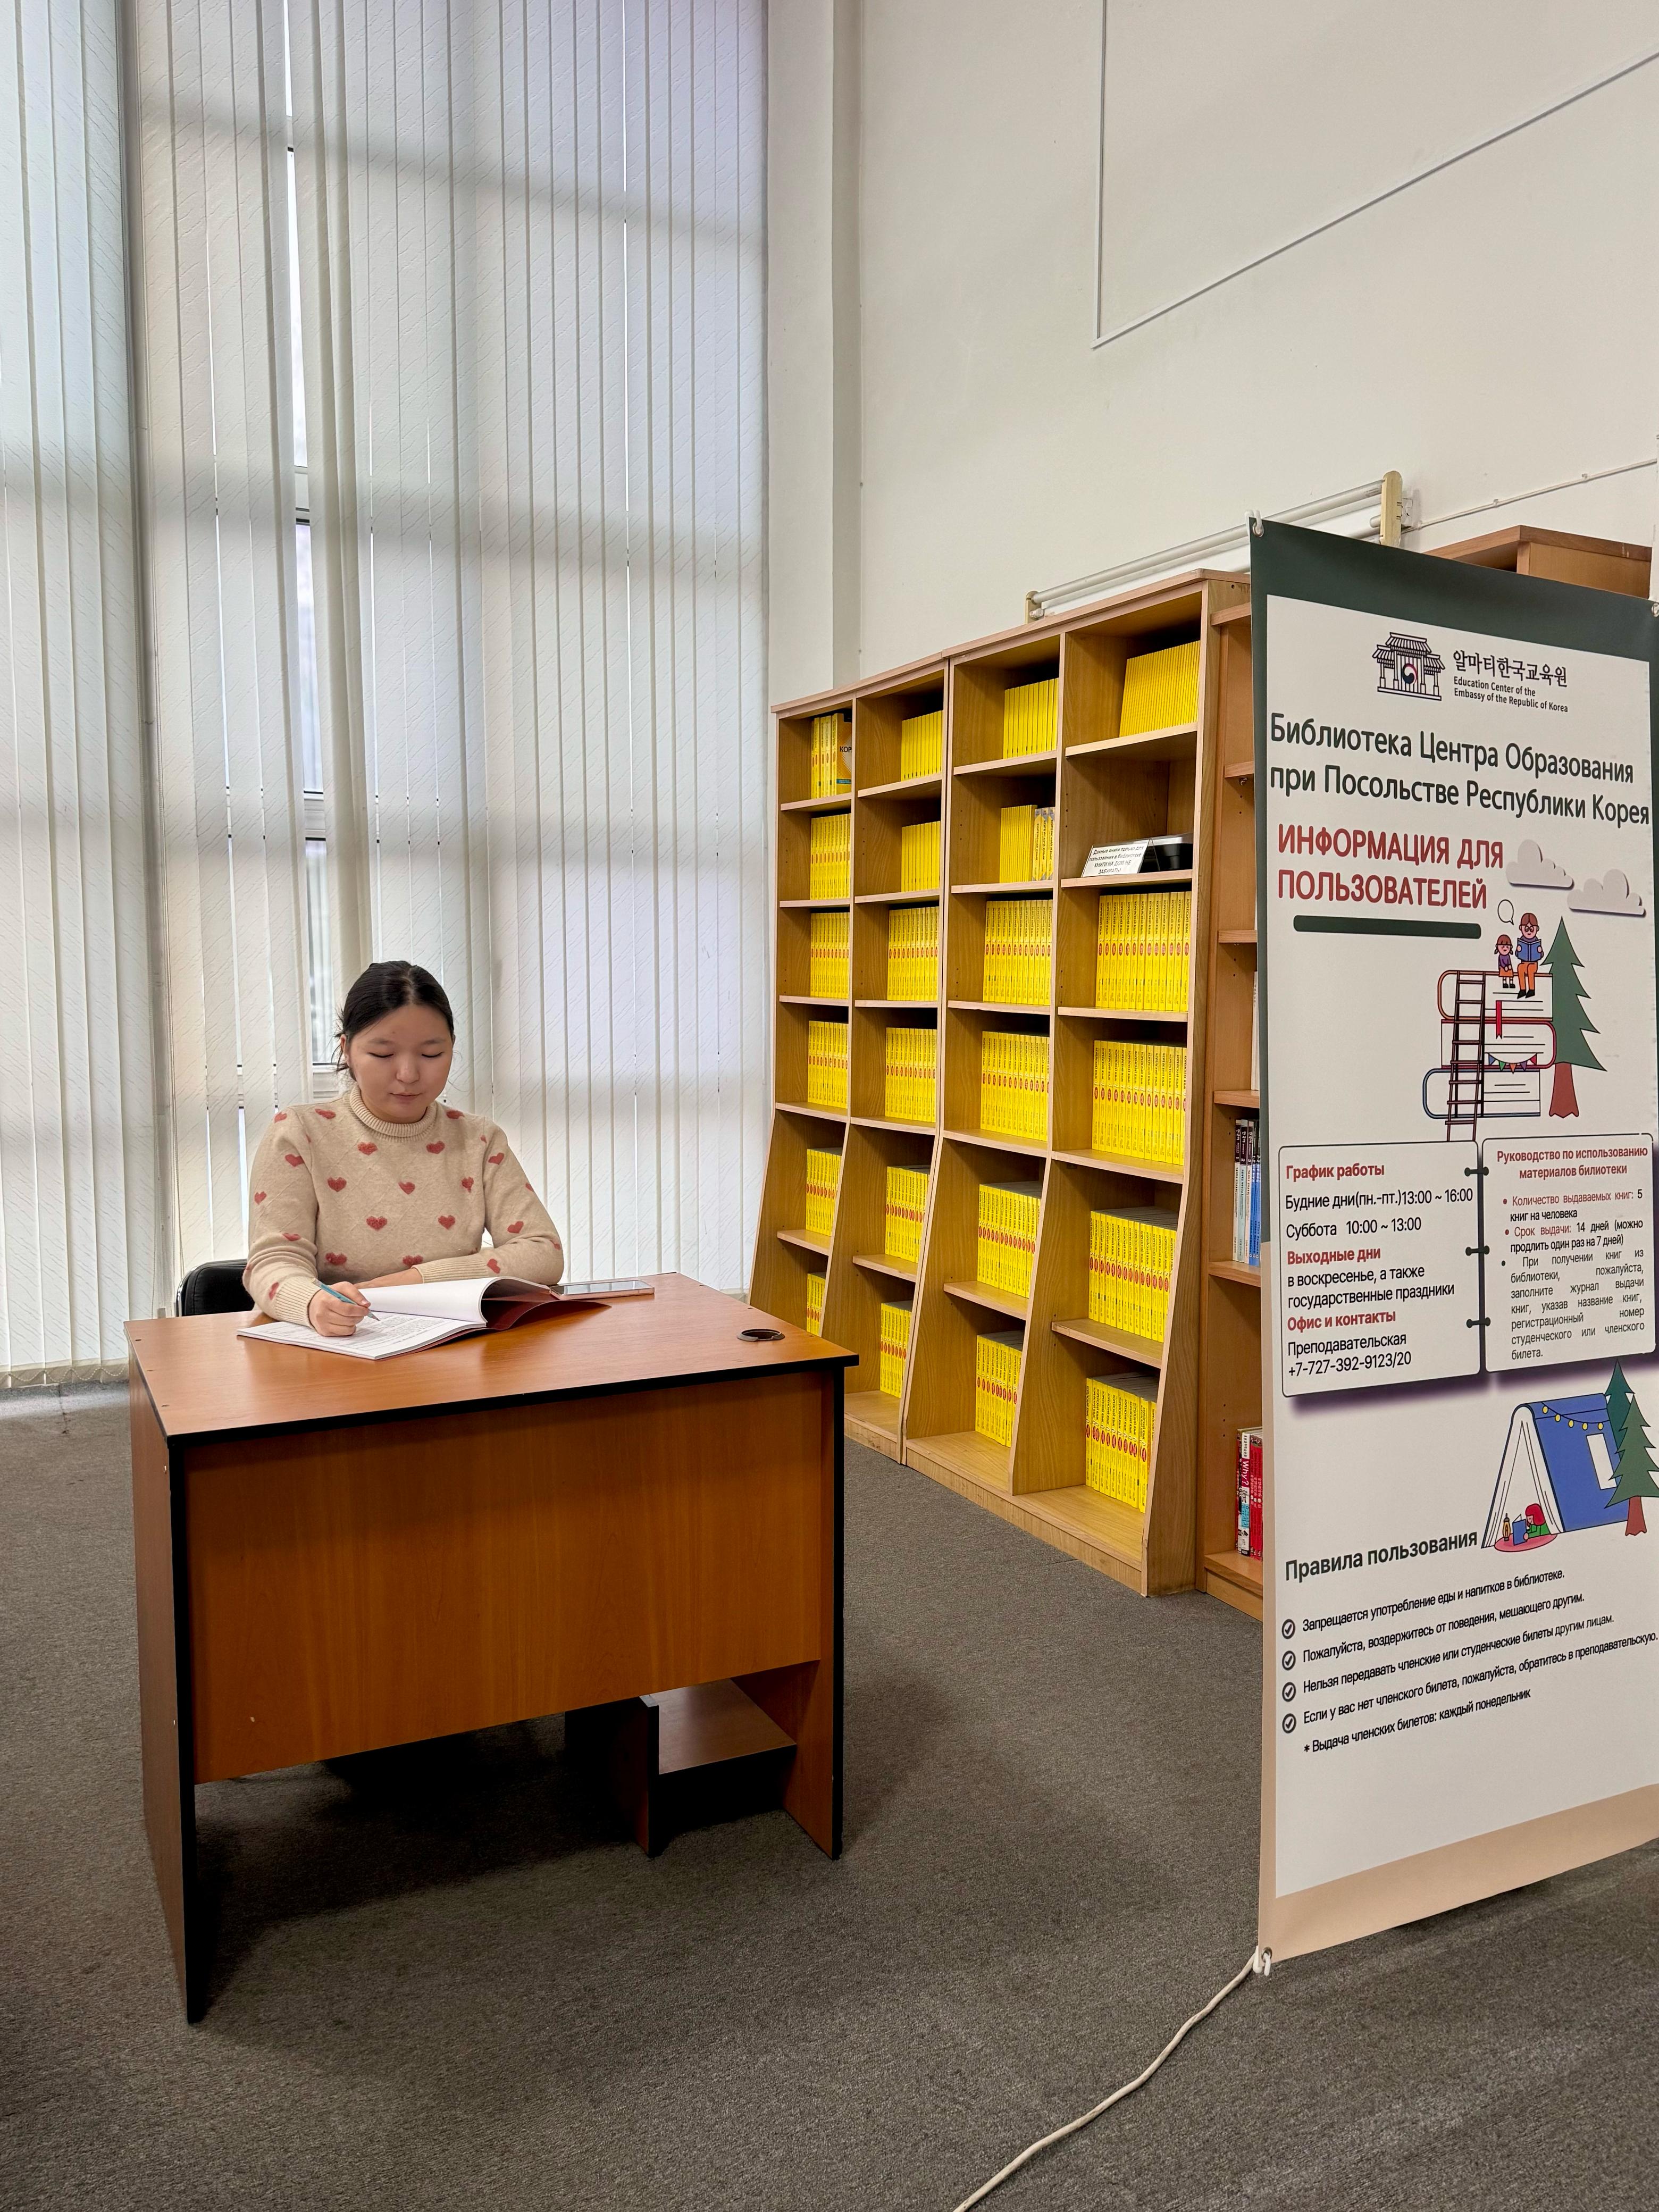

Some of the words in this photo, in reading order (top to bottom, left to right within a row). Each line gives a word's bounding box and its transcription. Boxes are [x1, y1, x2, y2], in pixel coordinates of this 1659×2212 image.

[1453, 650, 1567, 688] 알마티한국교육원
[1454, 676, 1489, 690] Education
[1491, 682, 1514, 693] Center
[1515, 686, 1523, 694] of
[1524, 687, 1536, 697] the
[1454, 688, 1485, 702] Embassy
[1487, 693, 1494, 701] of
[1495, 694, 1507, 703] the
[1509, 696, 1538, 708] Republic
[1540, 701, 1547, 709] of
[1549, 702, 1568, 712] Korea
[1271, 713, 1412, 757] Библиотека
[1420, 731, 1498, 772] Центра
[1505, 743, 1633, 784] Образования
[1271, 767, 1316, 797] при
[1325, 765, 1459, 805] Посольстве
[1467, 780, 1585, 818] Республики
[1593, 794, 1649, 828] Корея
[1279, 824, 1449, 866] ИНФОРМАЦИЯ
[1457, 839, 1503, 870] ДЛЯ
[1278, 869, 1486, 909] ПОЛЬЗОВАТЕЛЕЙ
[1497, 1151, 1561, 1164] Руководство
[1563, 1150, 1574, 1159] по
[1576, 1147, 1648, 1159] использованию
[1286, 1164, 1335, 1183] График
[1337, 1162, 1385, 1180] работы
[1519, 1168, 1577, 1180] материалов
[1286, 1195, 1330, 1212] Будние
[1445, 1188, 1473, 1202] 16:00
[1512, 1196, 1560, 1206] Количество
[1563, 1193, 1611, 1205] выдаваемых
[1615, 1192, 1633, 1200] книг:
[1637, 1189, 1643, 1199] 5
[1510, 1213, 1529, 1222] книг
[1530, 1212, 1540, 1221] на
[1541, 1210, 1578, 1220] человека
[1286, 1222, 1337, 1241] Суббота
[1346, 1219, 1378, 1234] 10:00
[1391, 1217, 1421, 1232] 13:00
[1514, 1226, 1535, 1239] Срок
[1540, 1225, 1571, 1236] выдачи:
[1577, 1222, 1586, 1233] 14
[1590, 1220, 1609, 1233] дней
[1614, 1219, 1643, 1231] (можно
[1287, 1250, 1355, 1265] Выходные
[1357, 1248, 1381, 1263] дни
[1511, 1242, 1549, 1255] продлить
[1551, 1240, 1570, 1251] один
[1571, 1239, 1585, 1250] раз
[1586, 1238, 1595, 1247] на
[1596, 1236, 1602, 1246] 7
[1603, 1234, 1623, 1247] дней)
[1523, 1256, 1538, 1269] При
[1552, 1253, 1593, 1266] получении
[1606, 1251, 1622, 1260] книг
[1288, 1276, 1294, 1287] в
[1297, 1270, 1377, 1288] воскресенье,
[1380, 1270, 1386, 1280] а
[1389, 1267, 1425, 1279] также
[1511, 1271, 1560, 1283] библиотеки,
[1596, 1264, 1644, 1276] пожалуйста,
[1288, 1289, 1393, 1310] государственные
[1396, 1284, 1454, 1302] праздники
[1511, 1287, 1553, 1299] заполните
[1570, 1283, 1599, 1295] журнал
[1615, 1278, 1644, 1289] выдачи
[1511, 1304, 1531, 1314] книг,
[1541, 1301, 1568, 1313] указав
[1578, 1296, 1613, 1308] название
[1622, 1293, 1641, 1303] книг,
[1287, 1316, 1322, 1333] Офис
[1325, 1317, 1332, 1327] и
[1336, 1311, 1396, 1327] контакты
[1511, 1312, 1583, 1332] регистрационный
[1619, 1308, 1645, 1318] номер
[1511, 1330, 1572, 1346] студенческого
[1581, 1328, 1596, 1337] или
[1605, 1322, 1645, 1334] членского
[1288, 1334, 1406, 1359] Преподавательская
[1512, 1349, 1543, 1360] билета.
[1288, 1351, 1411, 1377] +7-727-392-9123/20
[1286, 1553, 1363, 1583] Правила
[1368, 1531, 1477, 1565] пользования
[1303, 1610, 1368, 1631] Запрещается
[1370, 1596, 1436, 1621] употребление
[1438, 1592, 1455, 1605] еды
[1457, 1590, 1463, 1600] и
[1465, 1582, 1505, 1598] напитков
[1507, 1580, 1512, 1589] в
[1514, 1570, 1564, 1588] библиотеке.
[1303, 1641, 1365, 1662] Пожалуйста,
[1368, 1626, 1434, 1648] воздержитесь
[1436, 1623, 1447, 1633] от
[1448, 1612, 1497, 1631] поведения,
[1499, 1601, 1551, 1620] мешающего
[1553, 1594, 1585, 1610] другим.
[1304, 1677, 1338, 1693] Нельзя
[1341, 1664, 1396, 1685] передавать
[1398, 1653, 1440, 1671] членские
[1443, 1649, 1459, 1661] или
[1461, 1635, 1521, 1657] студенческие
[1522, 1628, 1553, 1642] билеты
[1555, 1621, 1585, 1637] другим
[1586, 1615, 1614, 1628] лицам.
[1304, 1710, 1327, 1724] Если
[1329, 1707, 1336, 1721] у
[1338, 1703, 1355, 1715] вас
[1358, 1698, 1374, 1711] нет
[1376, 1687, 1423, 1705] членского
[1426, 1679, 1460, 1694] билета,
[1462, 1665, 1516, 1686] пожалуйста,
[1519, 1653, 1566, 1672] обратитесь
[1568, 1651, 1573, 1660] в
[1575, 1632, 1658, 1660] преподавательскую.
[1312, 1735, 1349, 1753] Выдача
[1352, 1723, 1395, 1741] членских
[1397, 1713, 1437, 1731] билетов:
[1439, 1700, 1473, 1720] каждый
[1476, 1689, 1531, 1711] понедельник
